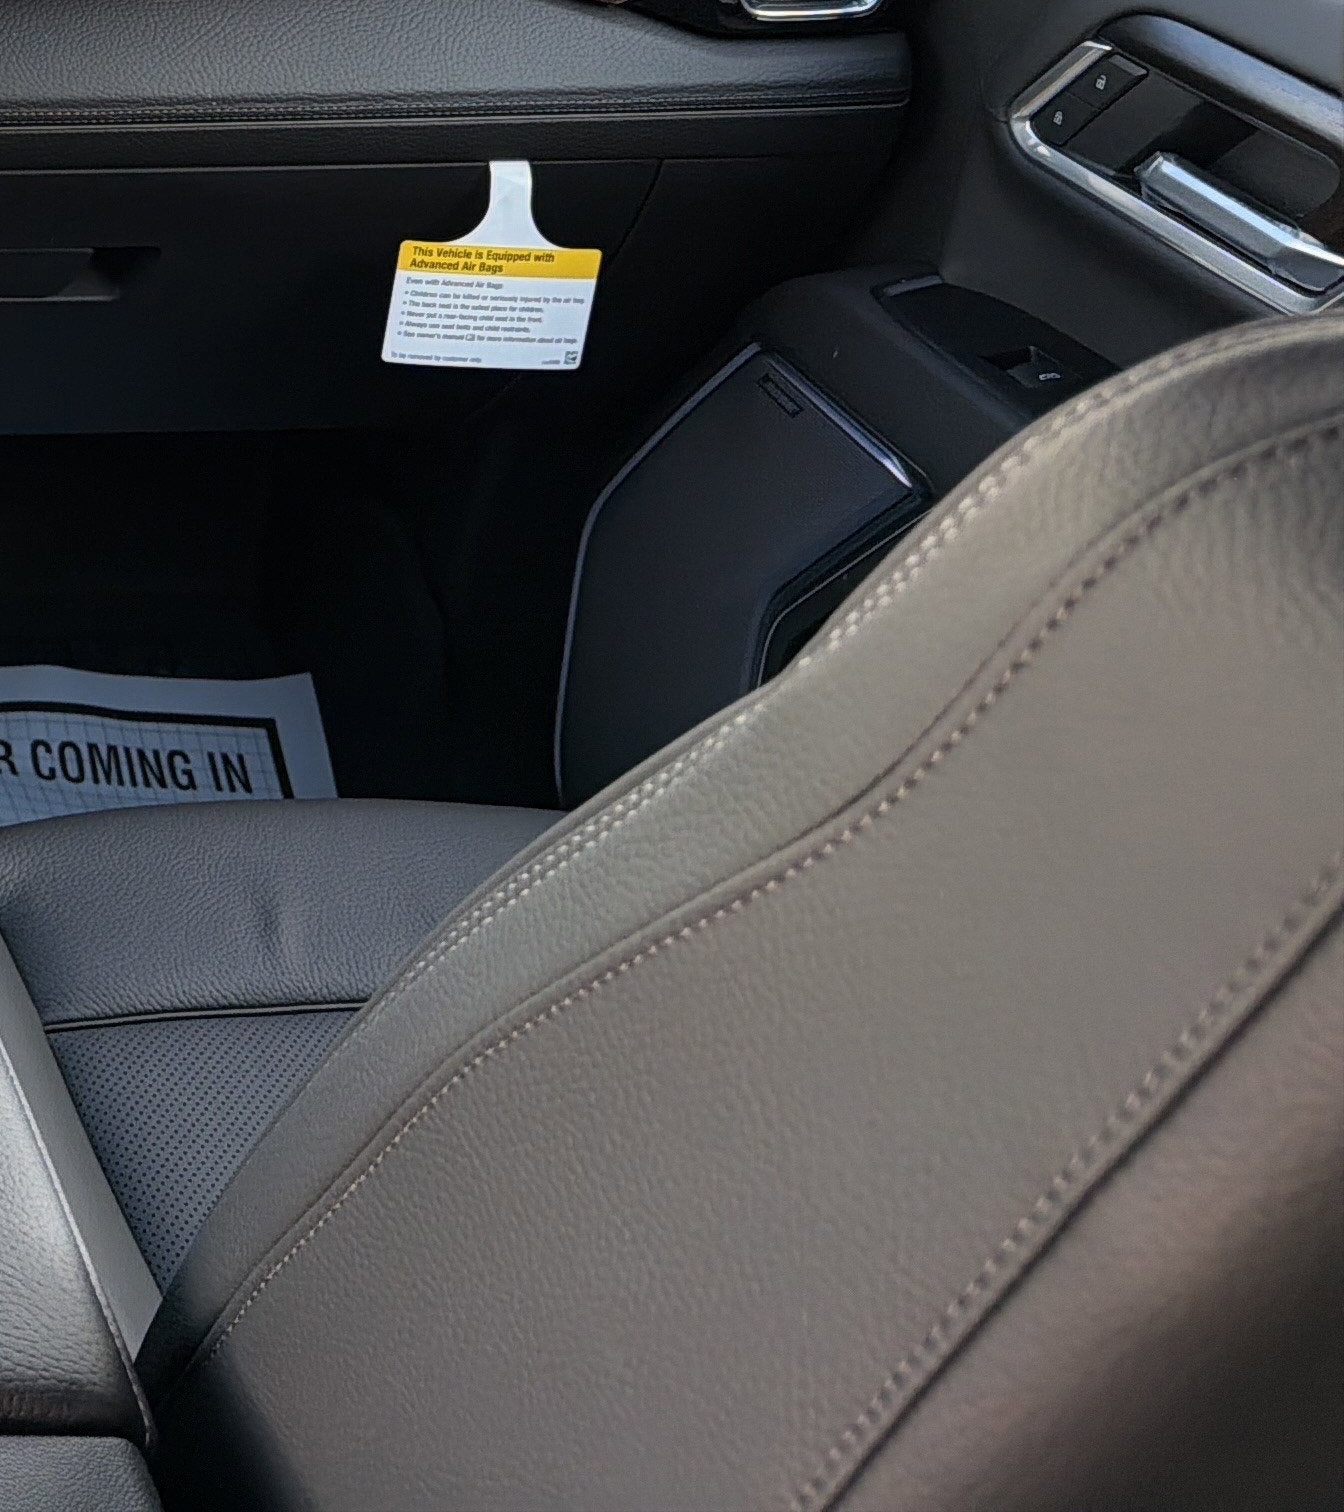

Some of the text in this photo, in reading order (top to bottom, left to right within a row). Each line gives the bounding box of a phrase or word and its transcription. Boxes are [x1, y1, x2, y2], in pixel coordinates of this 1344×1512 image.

[412, 246, 555, 263] This Vehicle is Equipped with
[409, 258, 504, 275] Advanced Air Bags
[30, 738, 197, 793] COMING
[207, 750, 253, 795] IN
